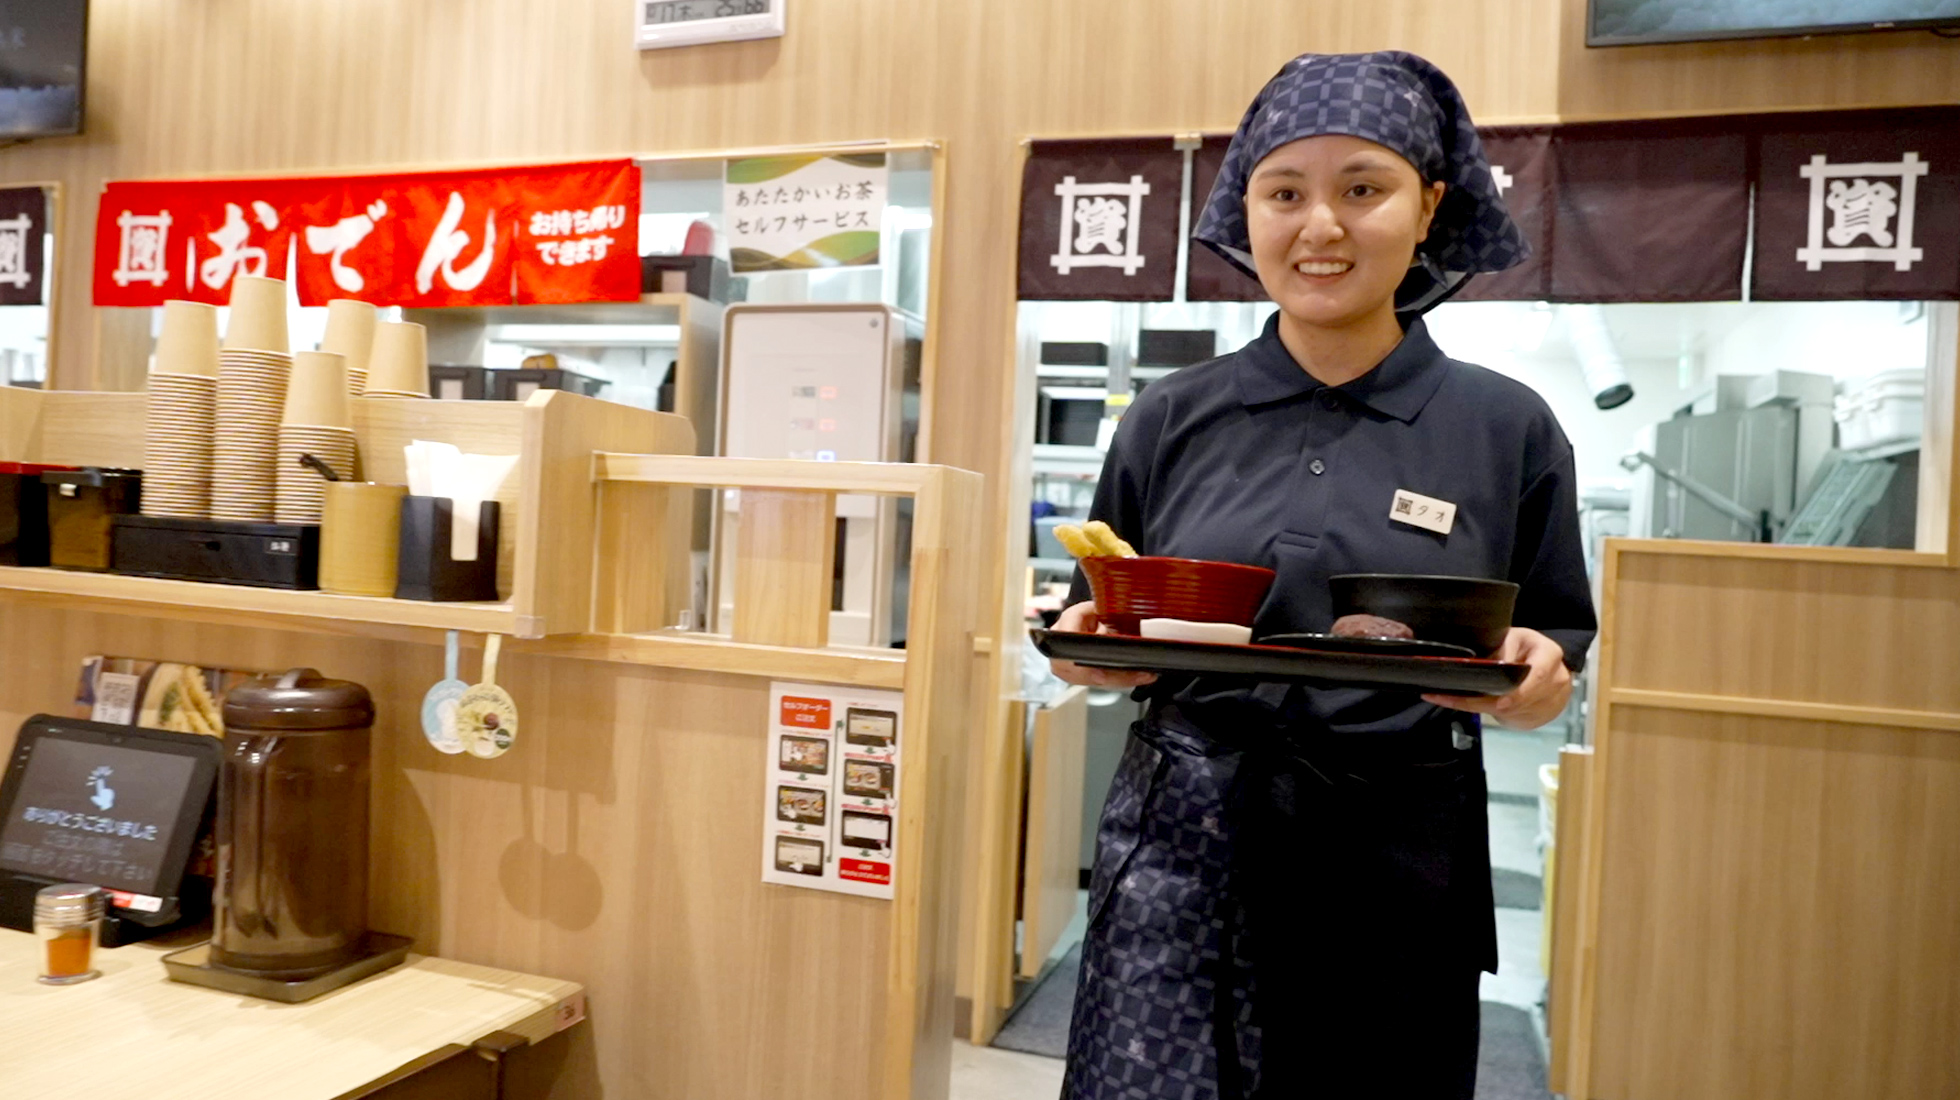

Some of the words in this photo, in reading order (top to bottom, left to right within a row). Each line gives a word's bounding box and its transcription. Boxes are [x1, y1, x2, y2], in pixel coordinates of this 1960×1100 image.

[735, 180, 874, 207] あたたかいお茶
[529, 204, 626, 236] お持ち帰り
[735, 211, 869, 235] セルフサービス
[200, 191, 496, 295] おでん
[536, 235, 615, 266] できます
